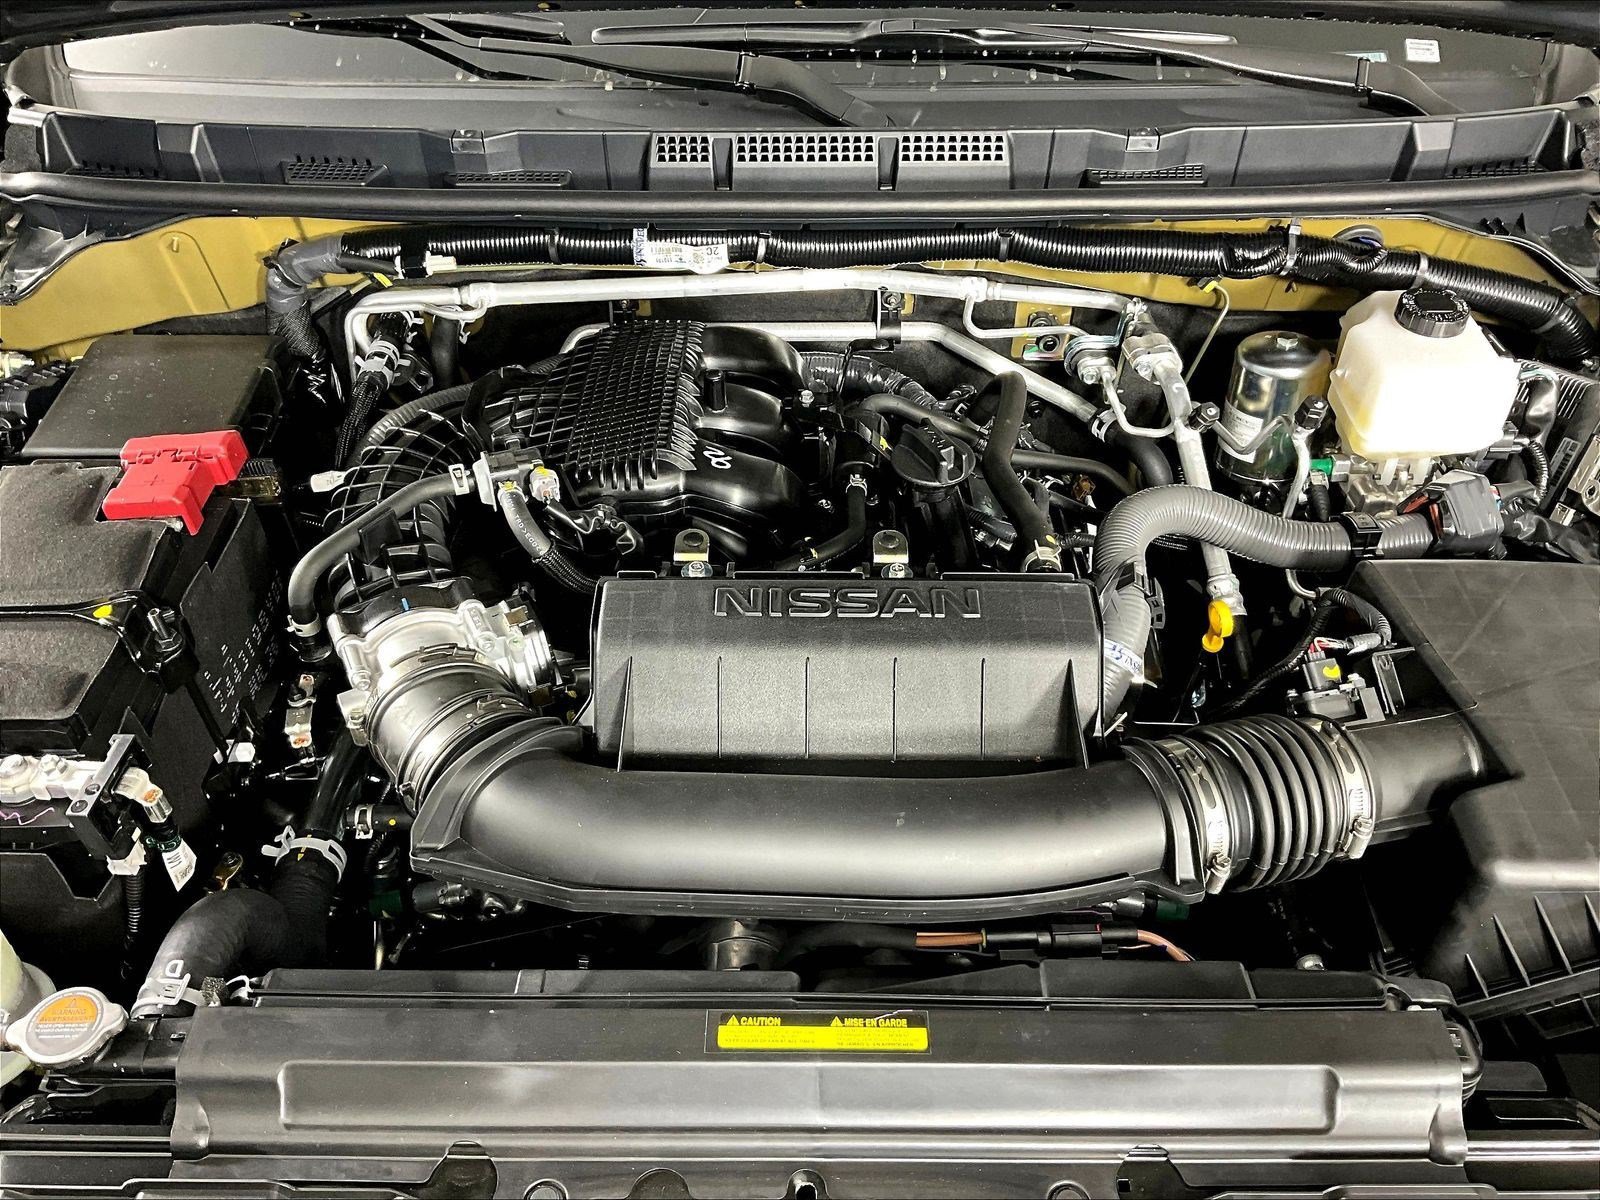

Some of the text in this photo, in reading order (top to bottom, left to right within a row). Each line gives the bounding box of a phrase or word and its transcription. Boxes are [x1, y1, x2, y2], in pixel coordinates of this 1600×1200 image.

[706, 246, 719, 256] 2C
[714, 587, 981, 618] NISSAN
[740, 1016, 781, 1026] CAUTION
[844, 1018, 908, 1027] MISE EN GARDE
